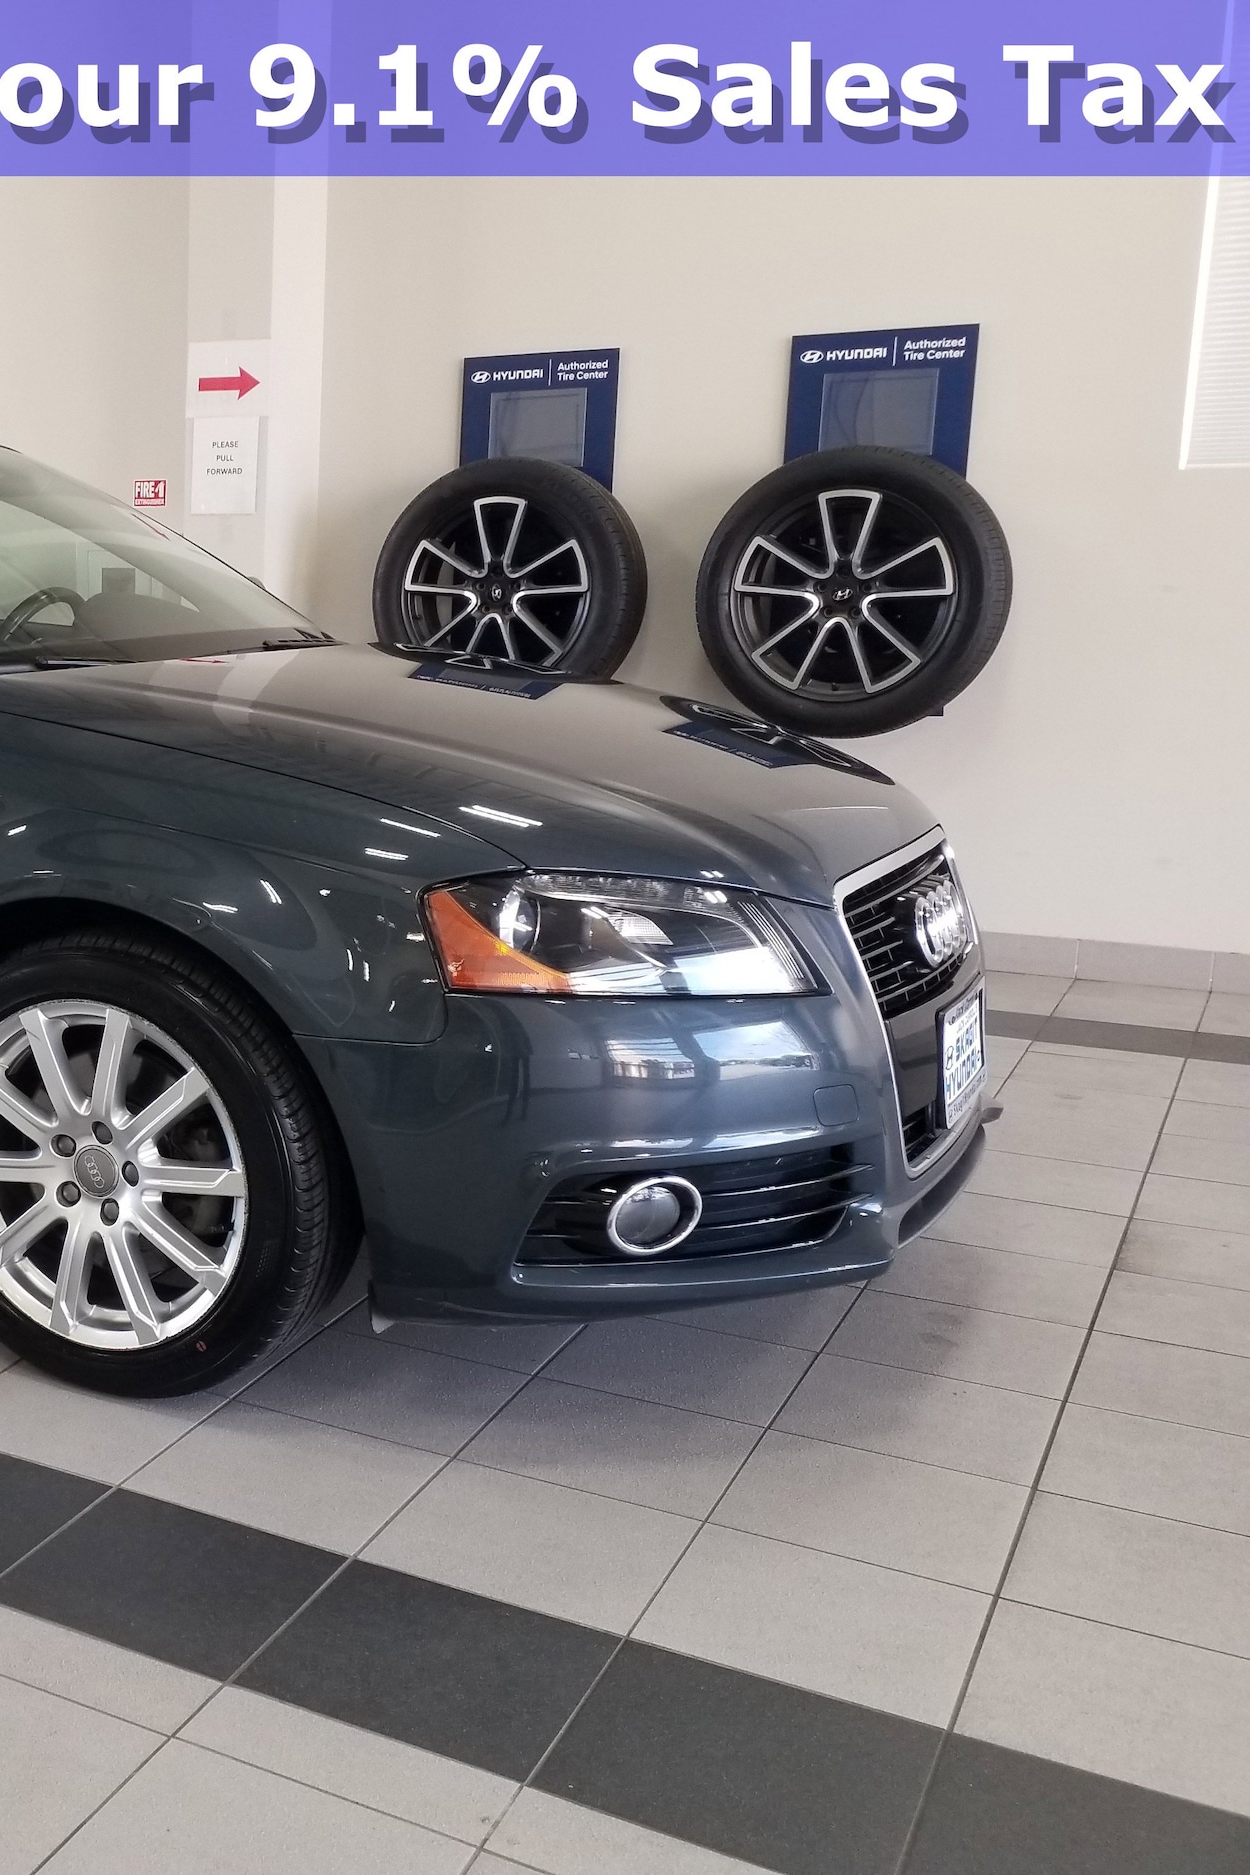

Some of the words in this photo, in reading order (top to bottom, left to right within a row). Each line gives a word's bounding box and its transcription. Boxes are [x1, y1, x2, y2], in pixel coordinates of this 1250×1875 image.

[903, 336, 967, 350] Authorized
[826, 347, 888, 361] HYUNDAI
[903, 351, 925, 361] Tire
[926, 349, 967, 360] Center
[557, 359, 609, 371] Authorized
[493, 369, 544, 381] HYUNDAI
[557, 372, 575, 381] Tire
[576, 370, 609, 380] Center
[135, 481, 155, 498] FIRE
